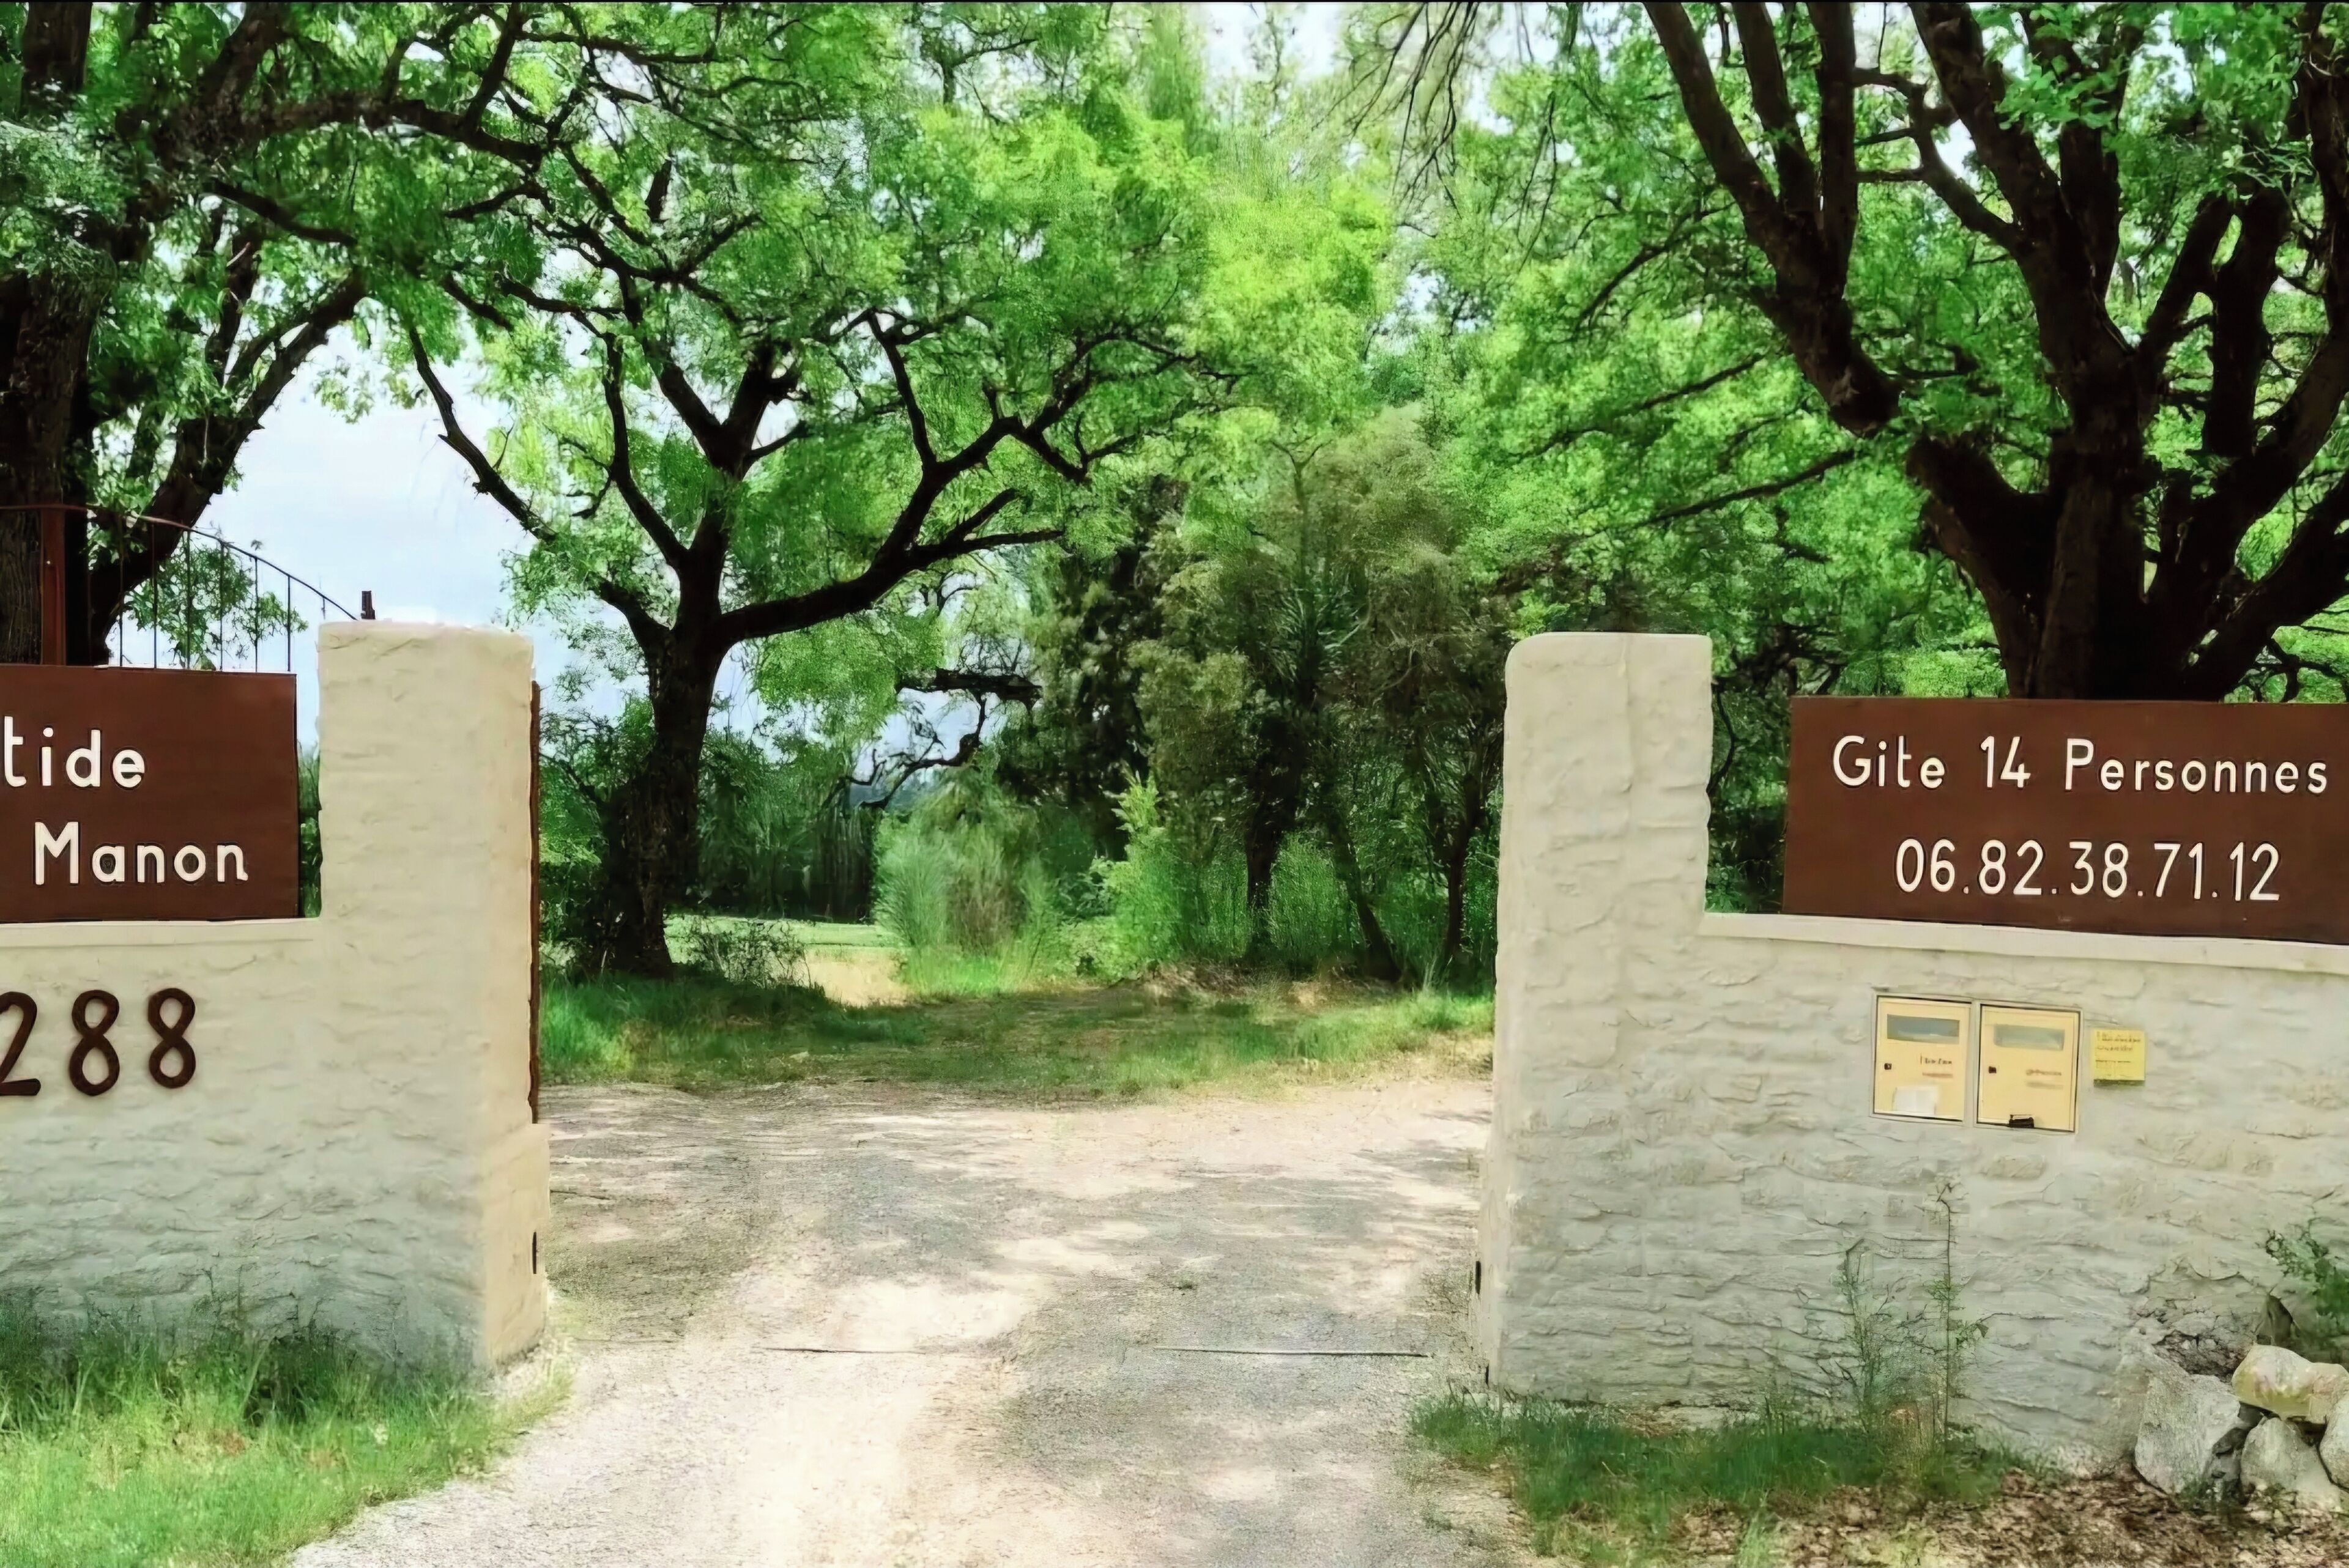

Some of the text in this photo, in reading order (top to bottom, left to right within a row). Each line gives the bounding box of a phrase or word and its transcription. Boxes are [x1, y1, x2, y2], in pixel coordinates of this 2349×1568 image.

[1833, 735, 2328, 794] Gite 14 Personnes
[35, 821, 248, 886] Manon
[1895, 838, 2280, 901] 06.82.38.71.12
[0, 988, 196, 1097] 288
